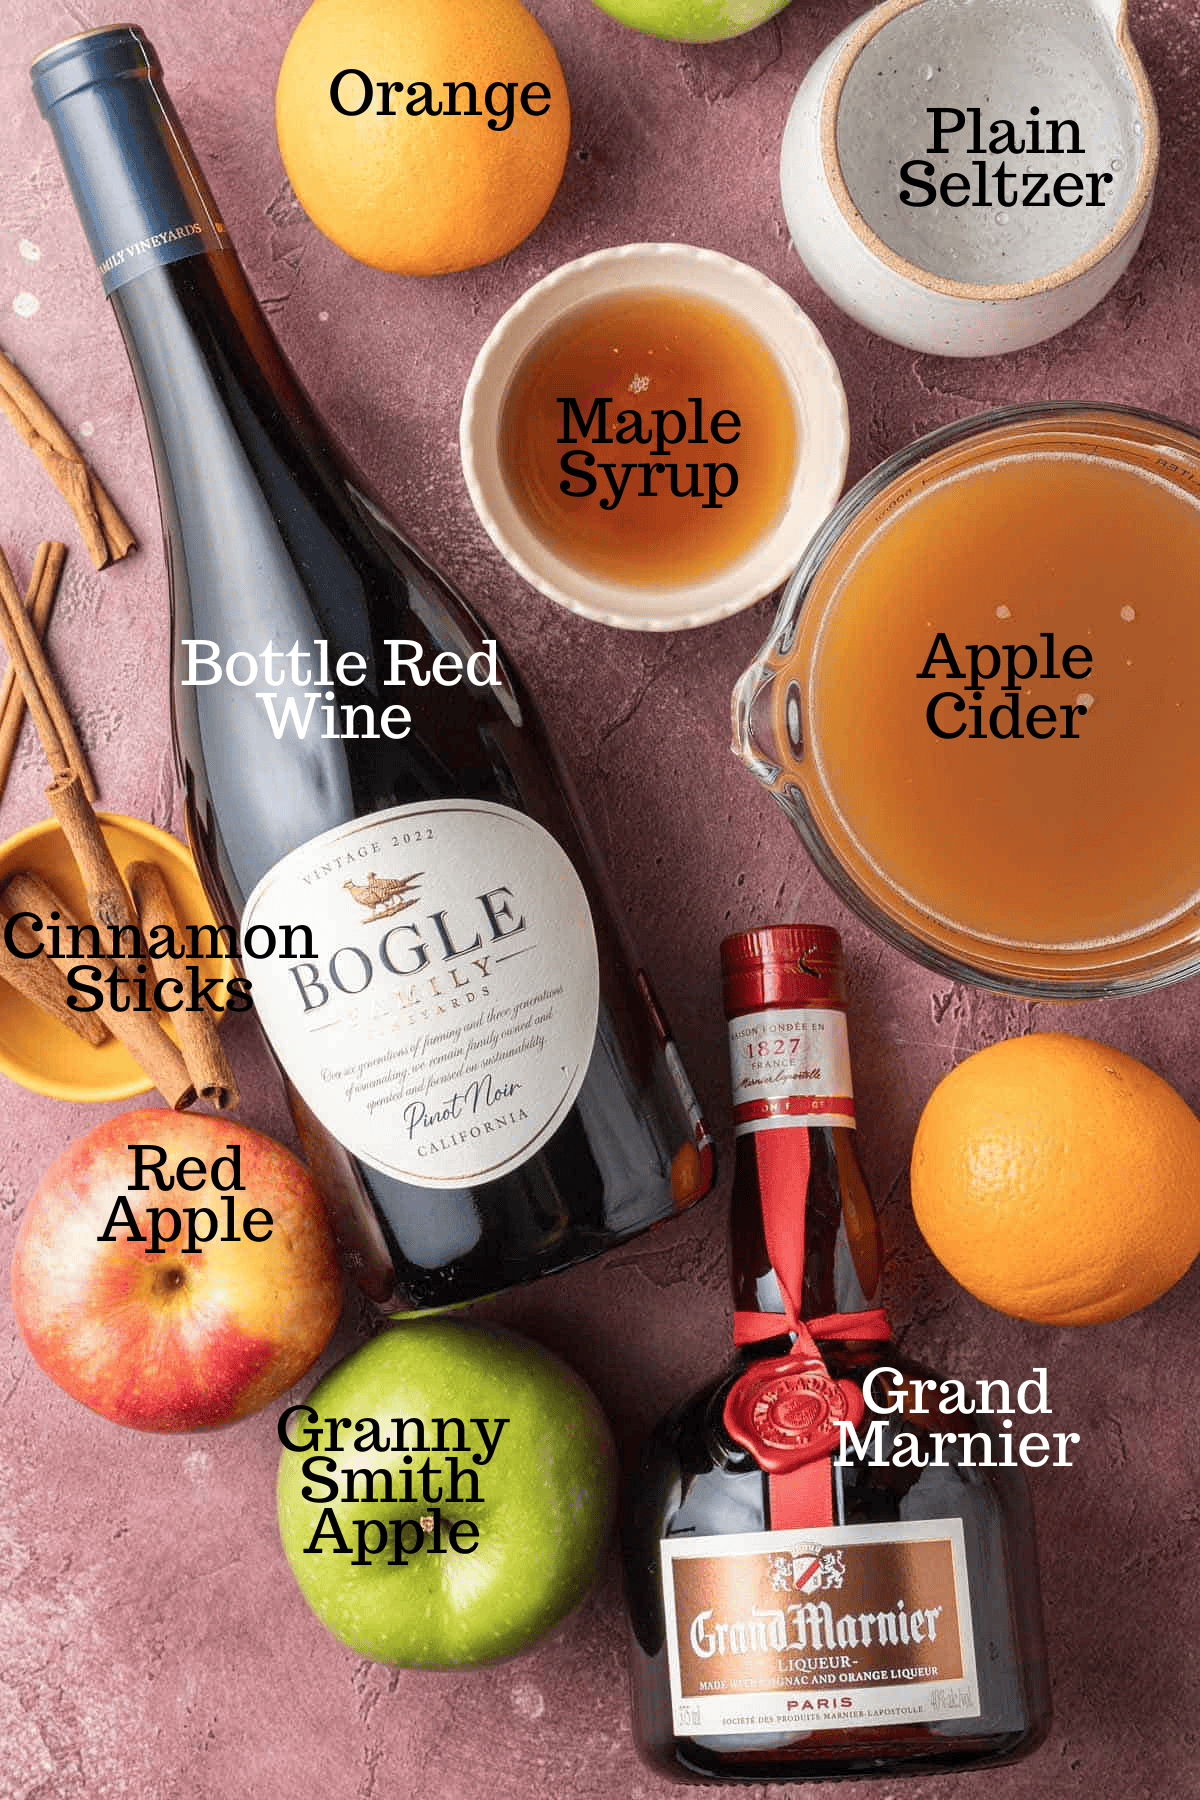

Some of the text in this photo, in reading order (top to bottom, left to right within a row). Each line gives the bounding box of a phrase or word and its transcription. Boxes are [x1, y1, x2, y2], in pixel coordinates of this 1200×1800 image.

[126, 223, 202, 257] VINEYARDS
[303, 828, 435, 887] VINTAGE 2022
[289, 885, 527, 1013] BOGLE
[811, 1023, 825, 1032] EN
[747, 1036, 801, 1058] 1827
[751, 1058, 797, 1070] FRANCE
[403, 1073, 522, 1139] Pinot Noir
[417, 1108, 529, 1157] CALIFORNIA
[689, 1599, 944, 1659] Grand Marnier
[759, 1675, 809, 1687] OGNAC
[812, 1673, 836, 1685] AND
[839, 1670, 889, 1682] ORANGE
[890, 1666, 939, 1680] LIQUEUR
[786, 1696, 854, 1711] PARIS
